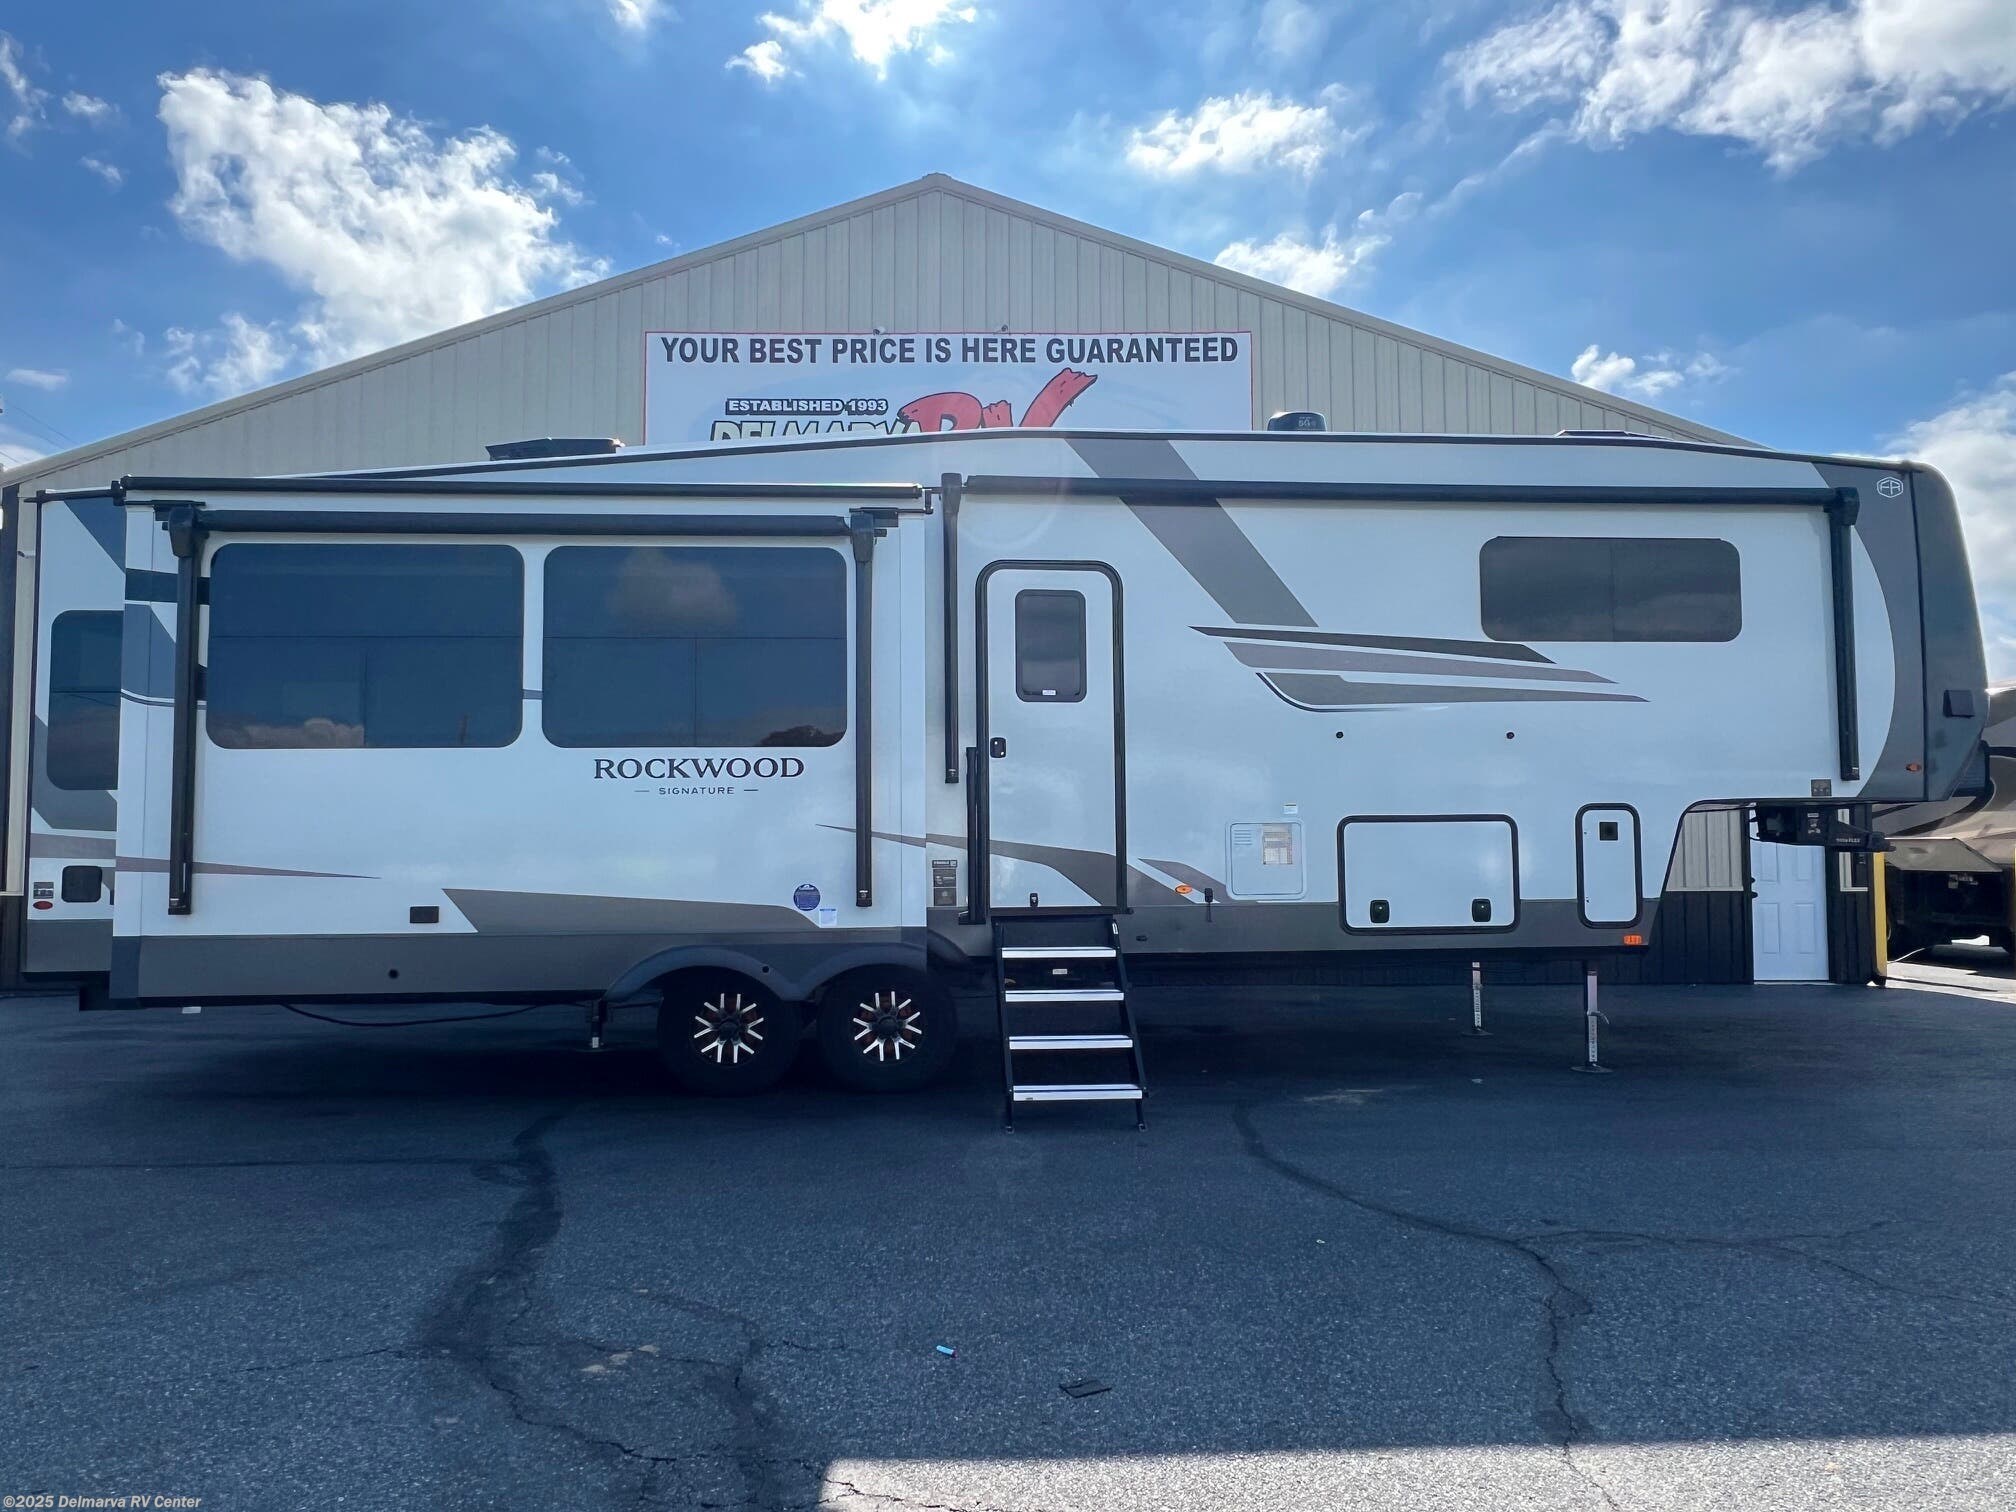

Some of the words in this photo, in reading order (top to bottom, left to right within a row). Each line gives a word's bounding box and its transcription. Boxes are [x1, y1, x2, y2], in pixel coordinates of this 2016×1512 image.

[661, 337, 739, 363] YOUR
[750, 338, 822, 363] BEST
[832, 338, 915, 363] PRICE
[925, 338, 952, 363] IS
[961, 338, 1036, 363] HERE
[1046, 337, 1238, 363] GUARANTEED
[728, 400, 843, 412] ESTABLISHED
[847, 399, 887, 412] 1993
[594, 757, 805, 779] ROCKWOOD
[658, 787, 735, 795] SIGNATURE
